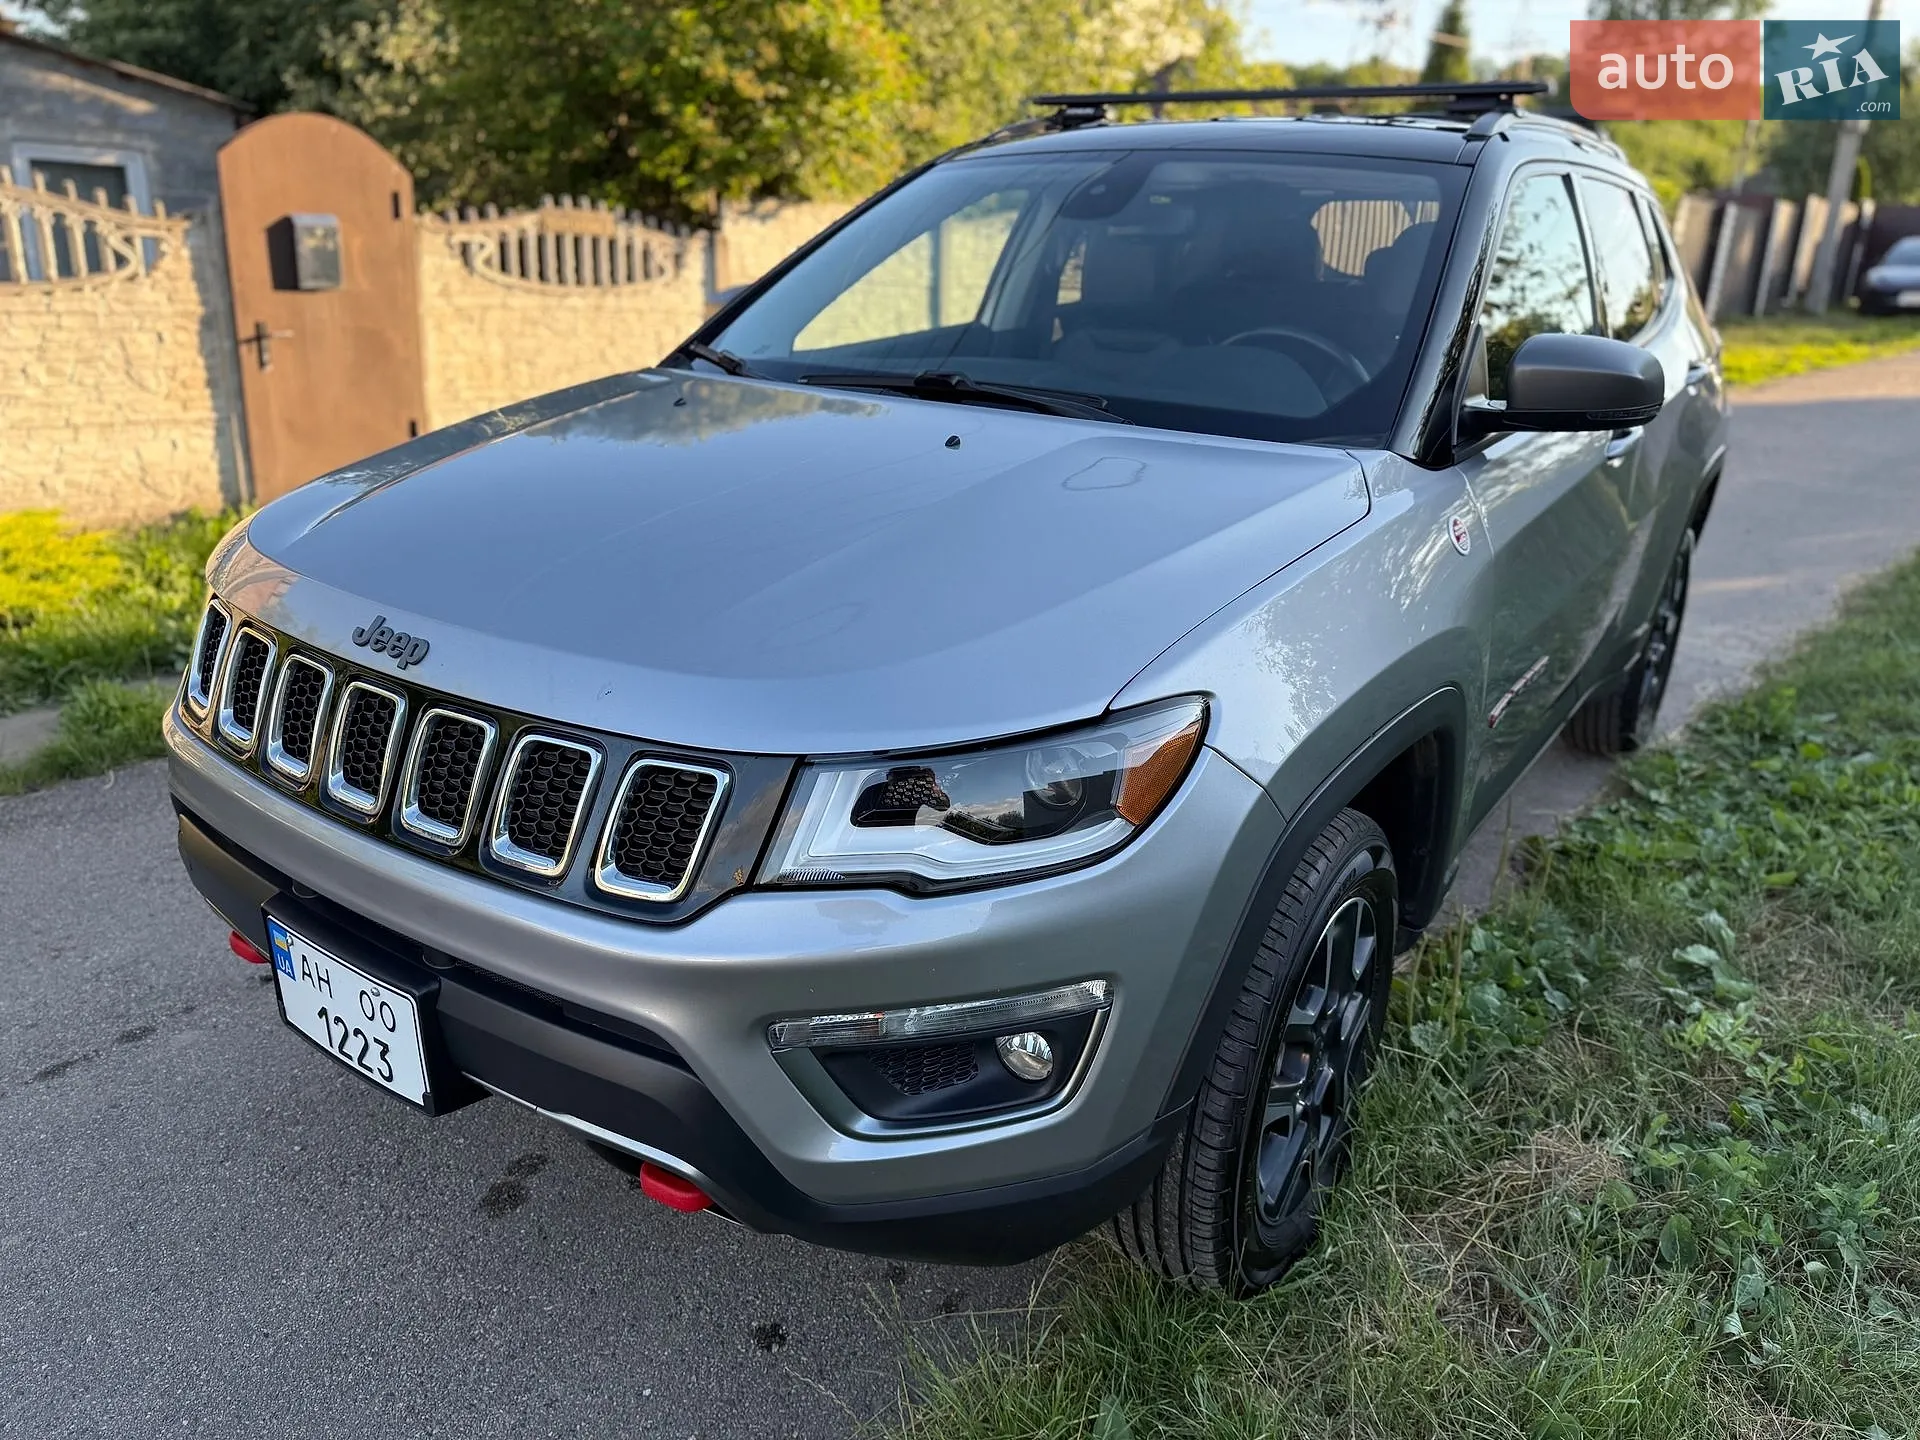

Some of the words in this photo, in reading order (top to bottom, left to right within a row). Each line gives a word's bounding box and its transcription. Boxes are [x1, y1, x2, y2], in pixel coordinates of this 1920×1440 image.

[352, 615, 430, 670] Jeep
[277, 955, 294, 977] UA
[301, 954, 333, 999] AH
[317, 1006, 394, 1083] 1223
